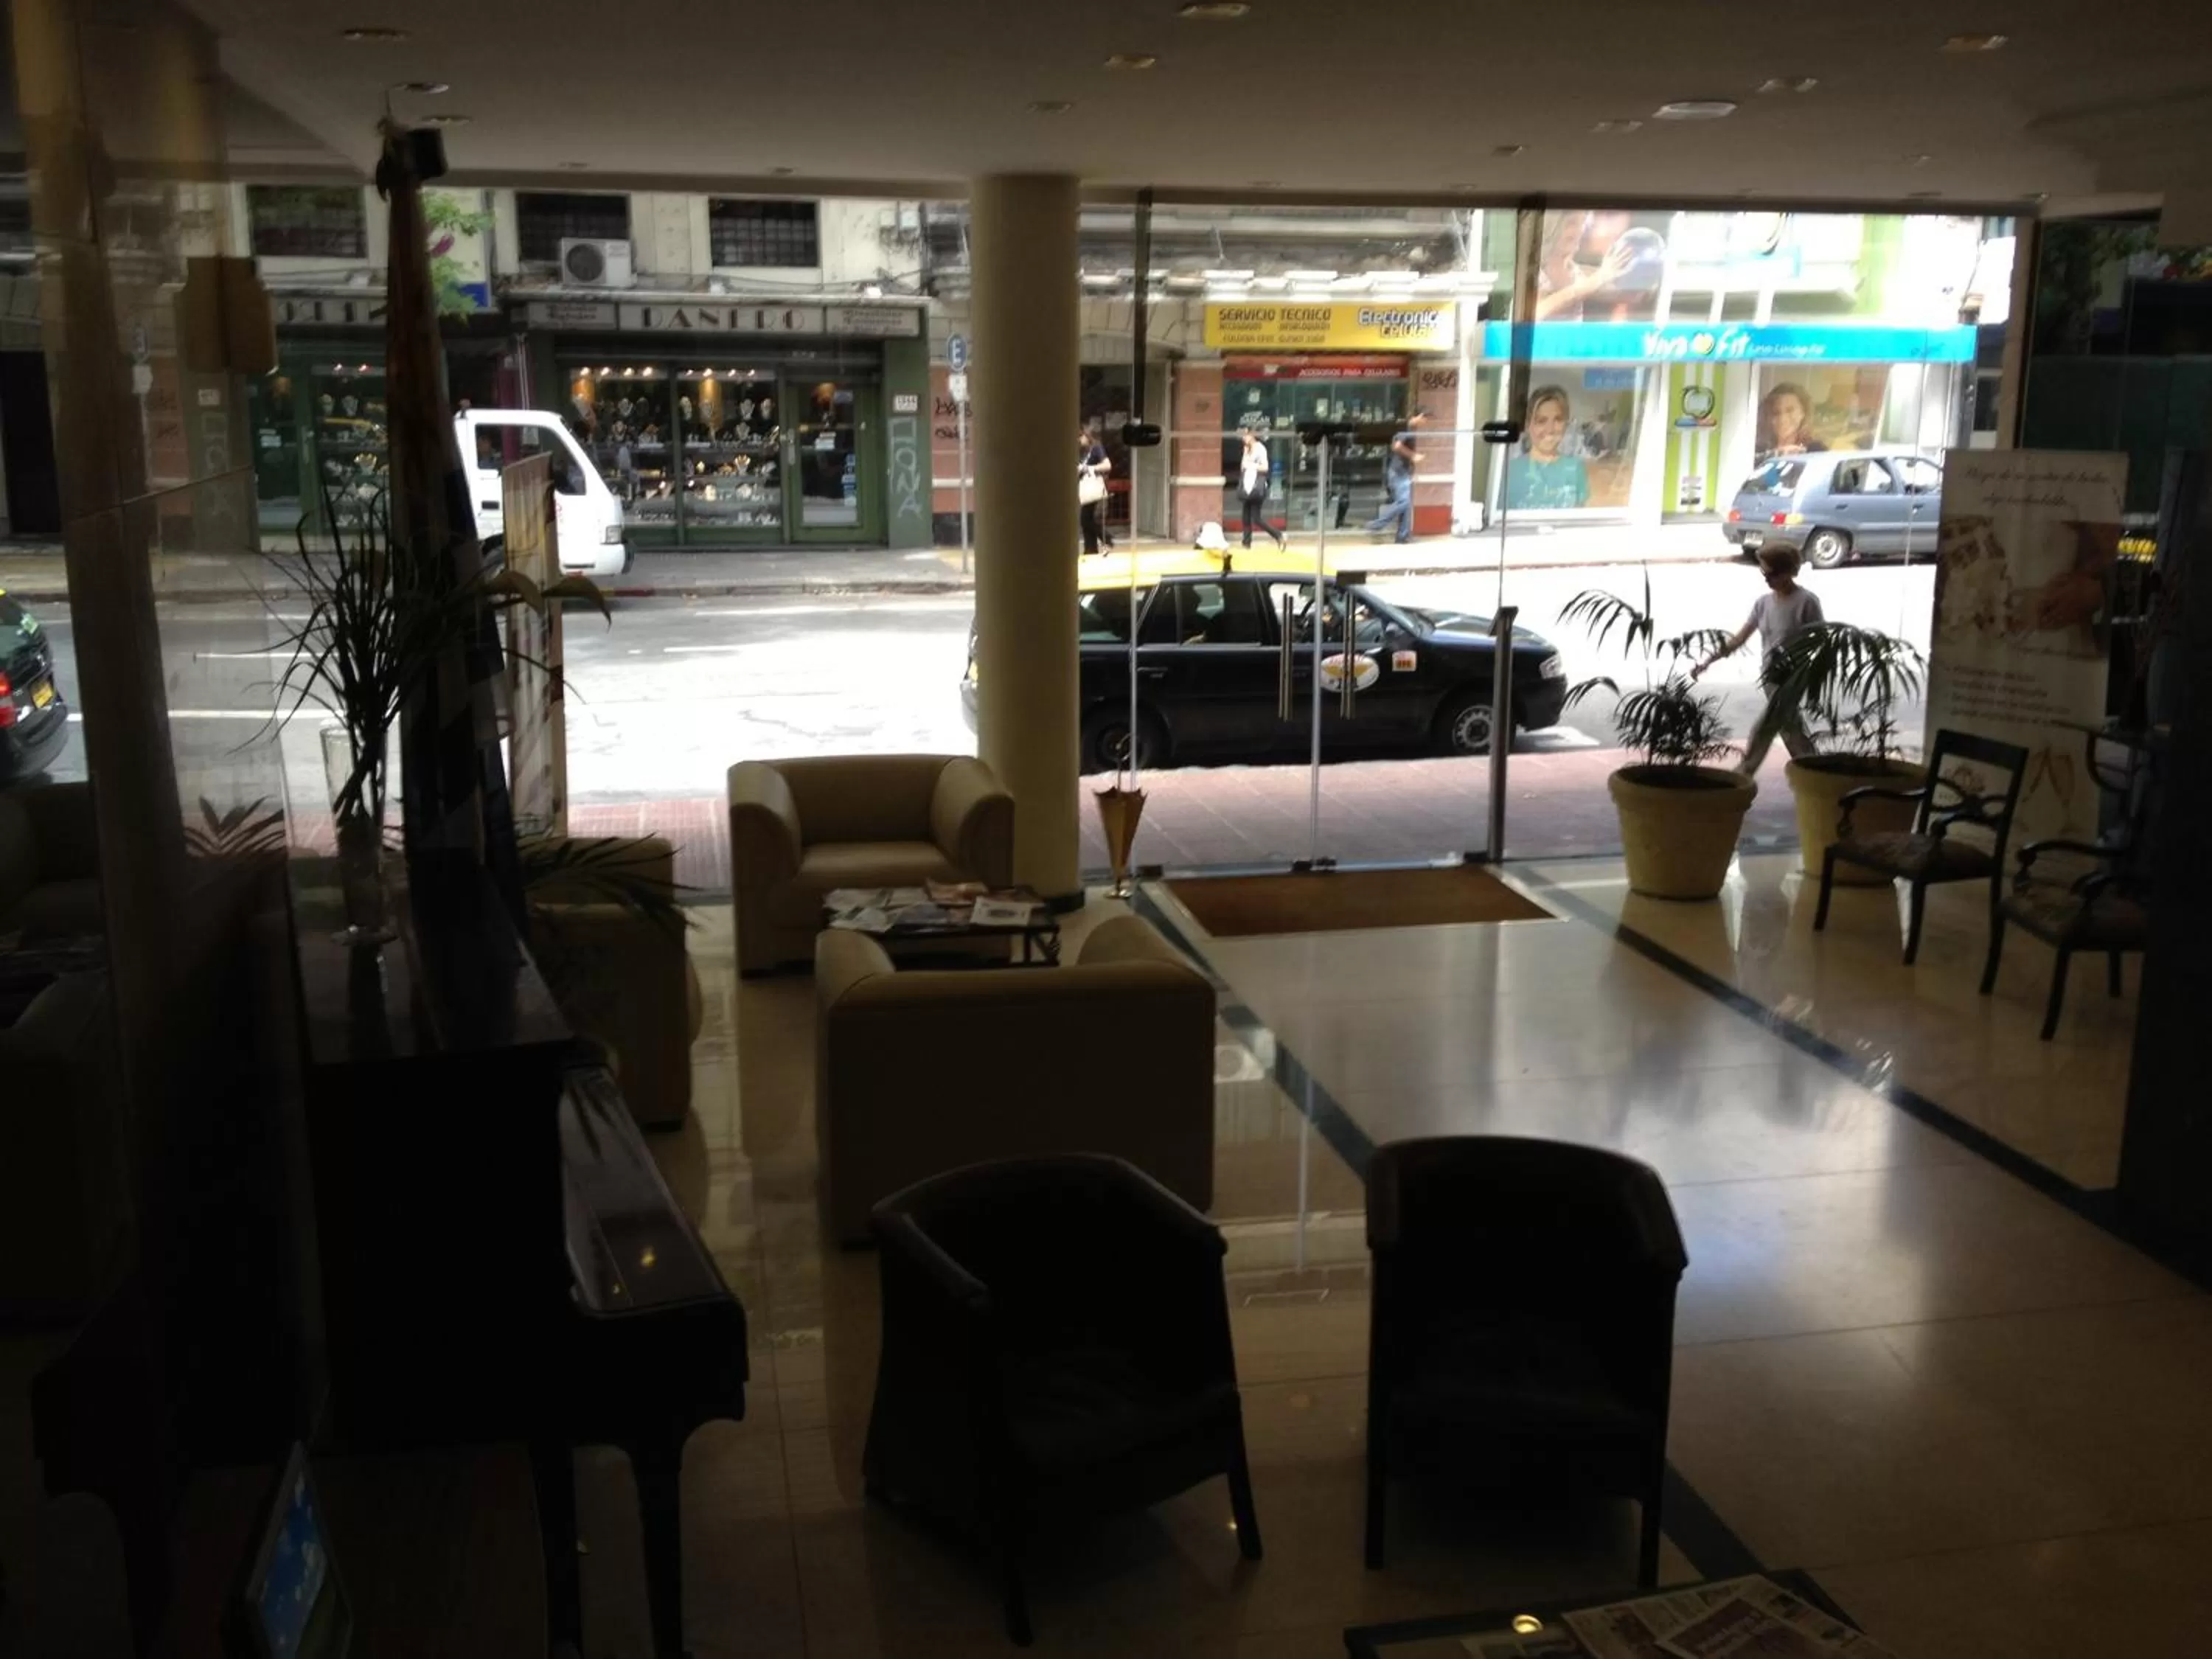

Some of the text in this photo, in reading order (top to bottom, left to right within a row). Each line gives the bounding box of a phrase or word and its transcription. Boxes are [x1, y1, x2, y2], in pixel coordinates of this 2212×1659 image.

[1219, 307, 1331, 321] SERVICIO TECNICO
[1358, 307, 1439, 327] Electronic
[951, 339, 963, 364] E
